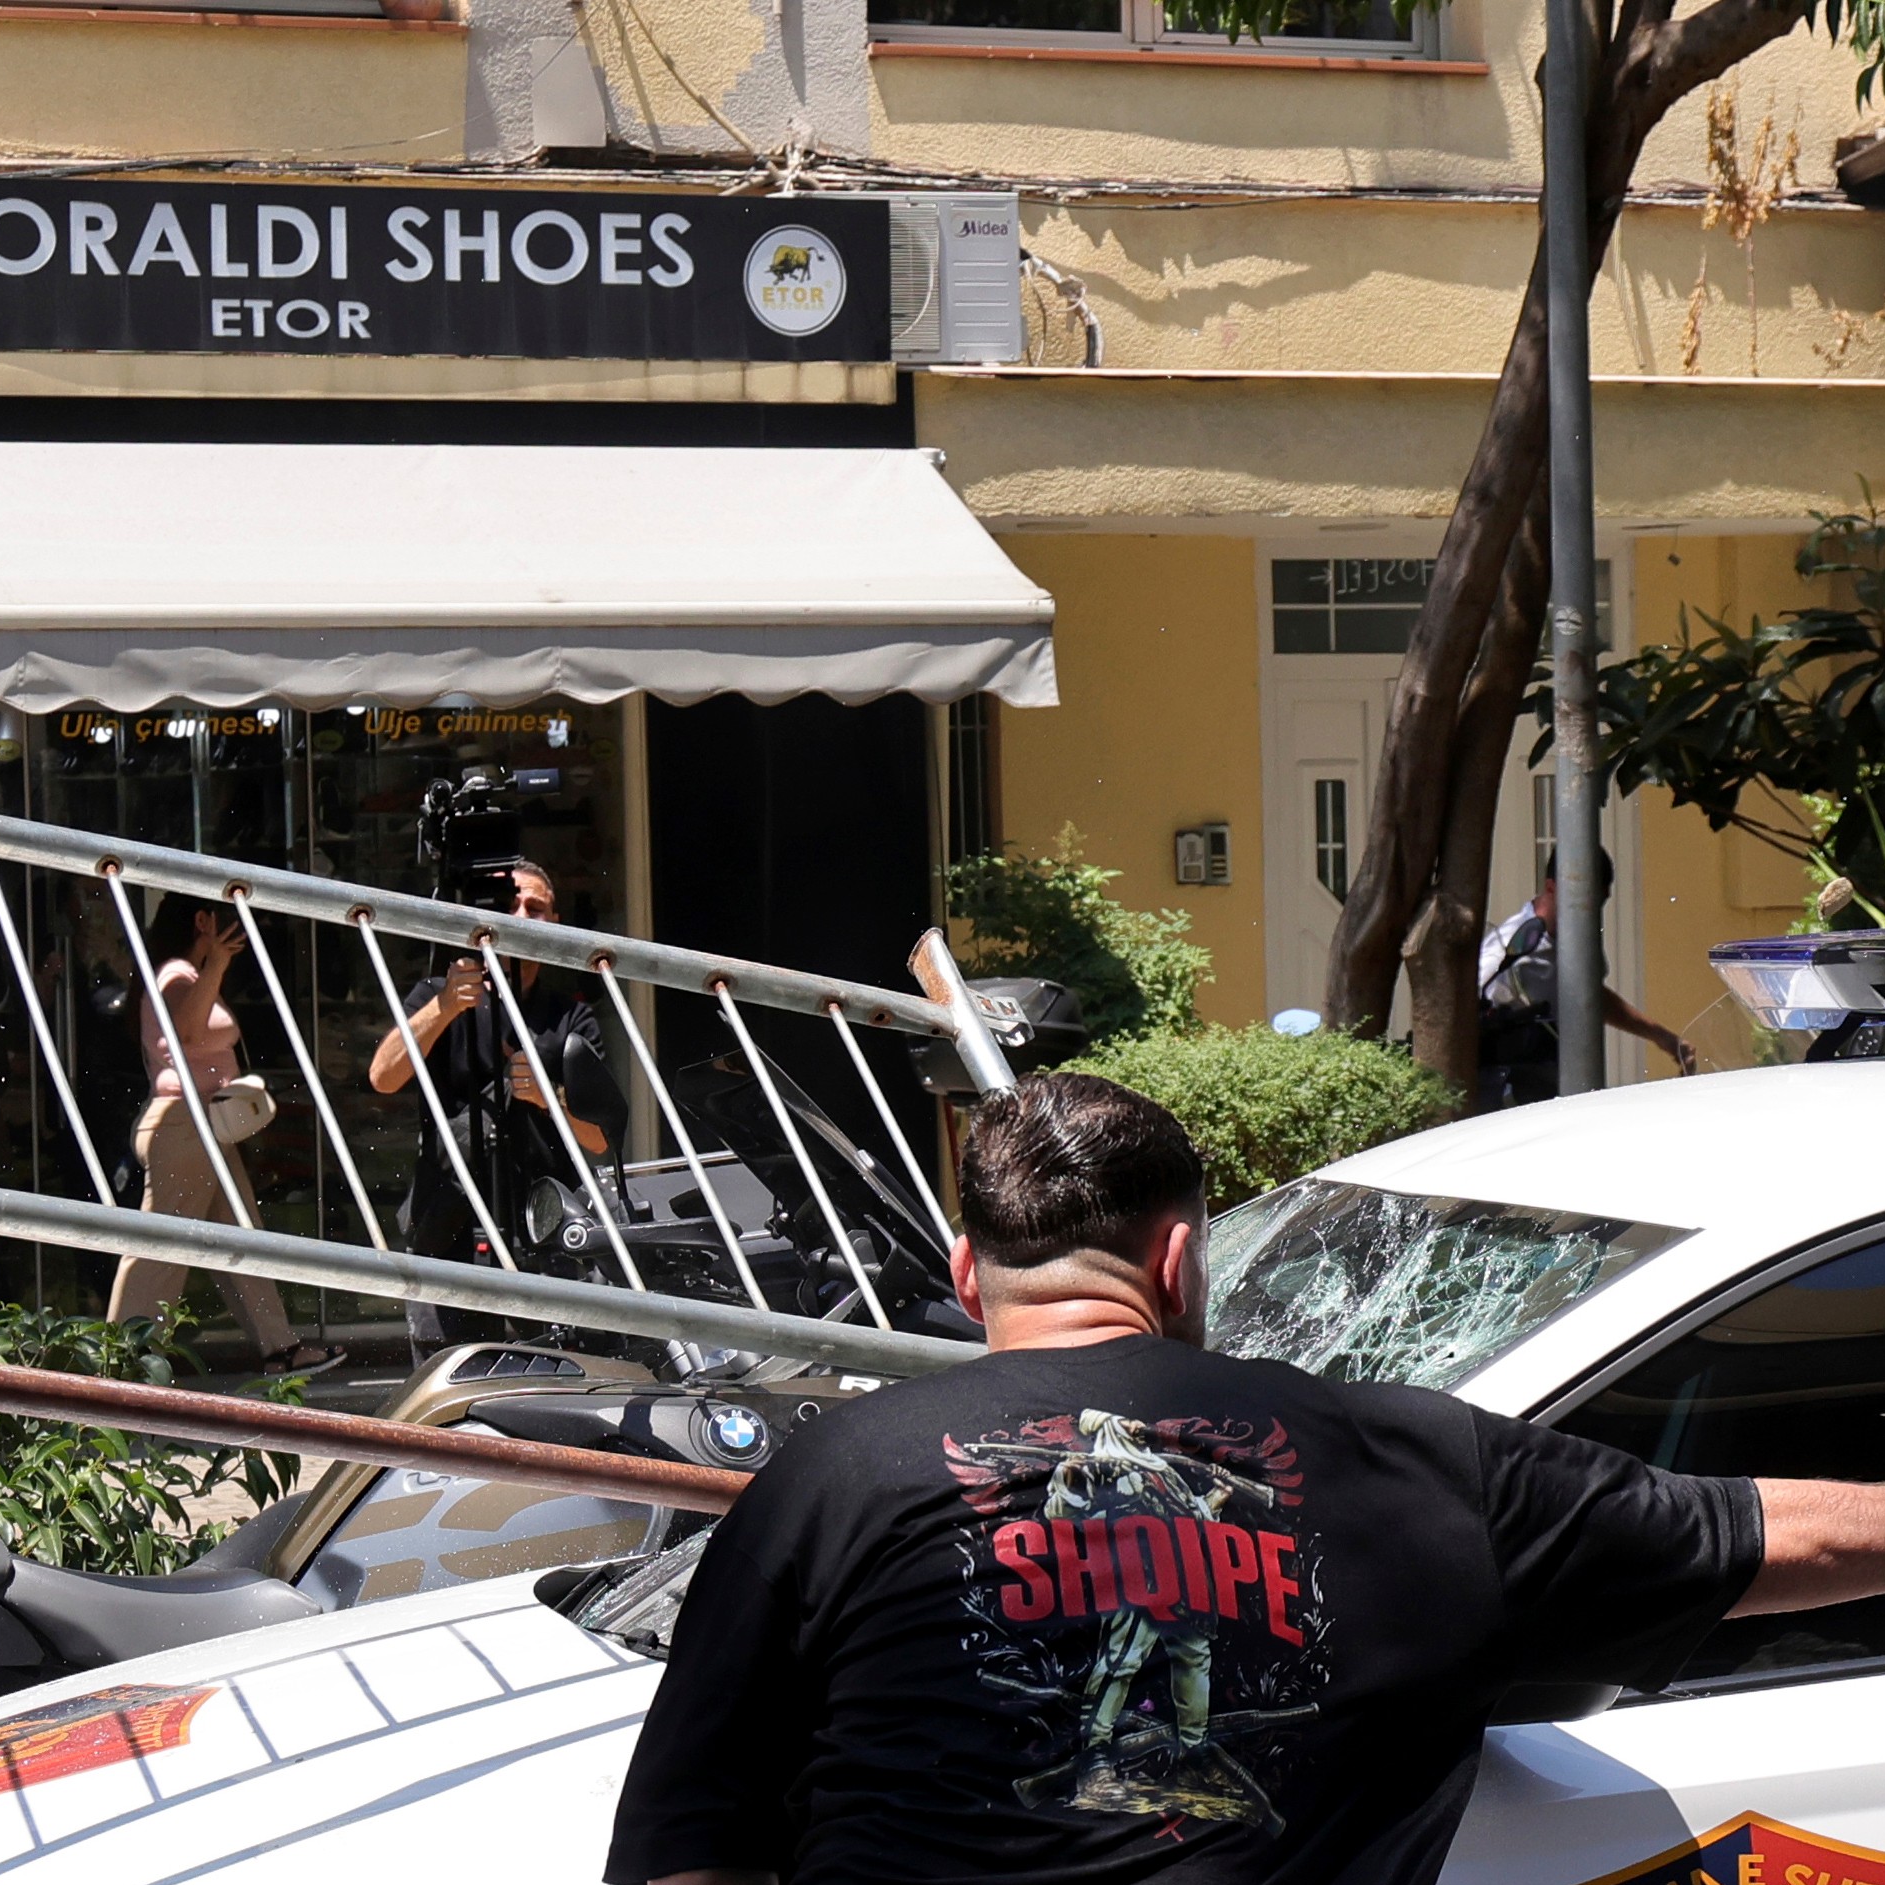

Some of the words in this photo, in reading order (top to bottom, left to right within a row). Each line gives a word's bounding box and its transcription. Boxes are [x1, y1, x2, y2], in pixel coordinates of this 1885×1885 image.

[958, 219, 1008, 237] Midea
[385, 207, 695, 287] SHOES
[762, 286, 824, 303] ETOR
[211, 299, 371, 340] ETOR
[364, 709, 422, 740] Ulje
[715, 1409, 760, 1427] BMW
[993, 1515, 1303, 1647] SHQIPE
